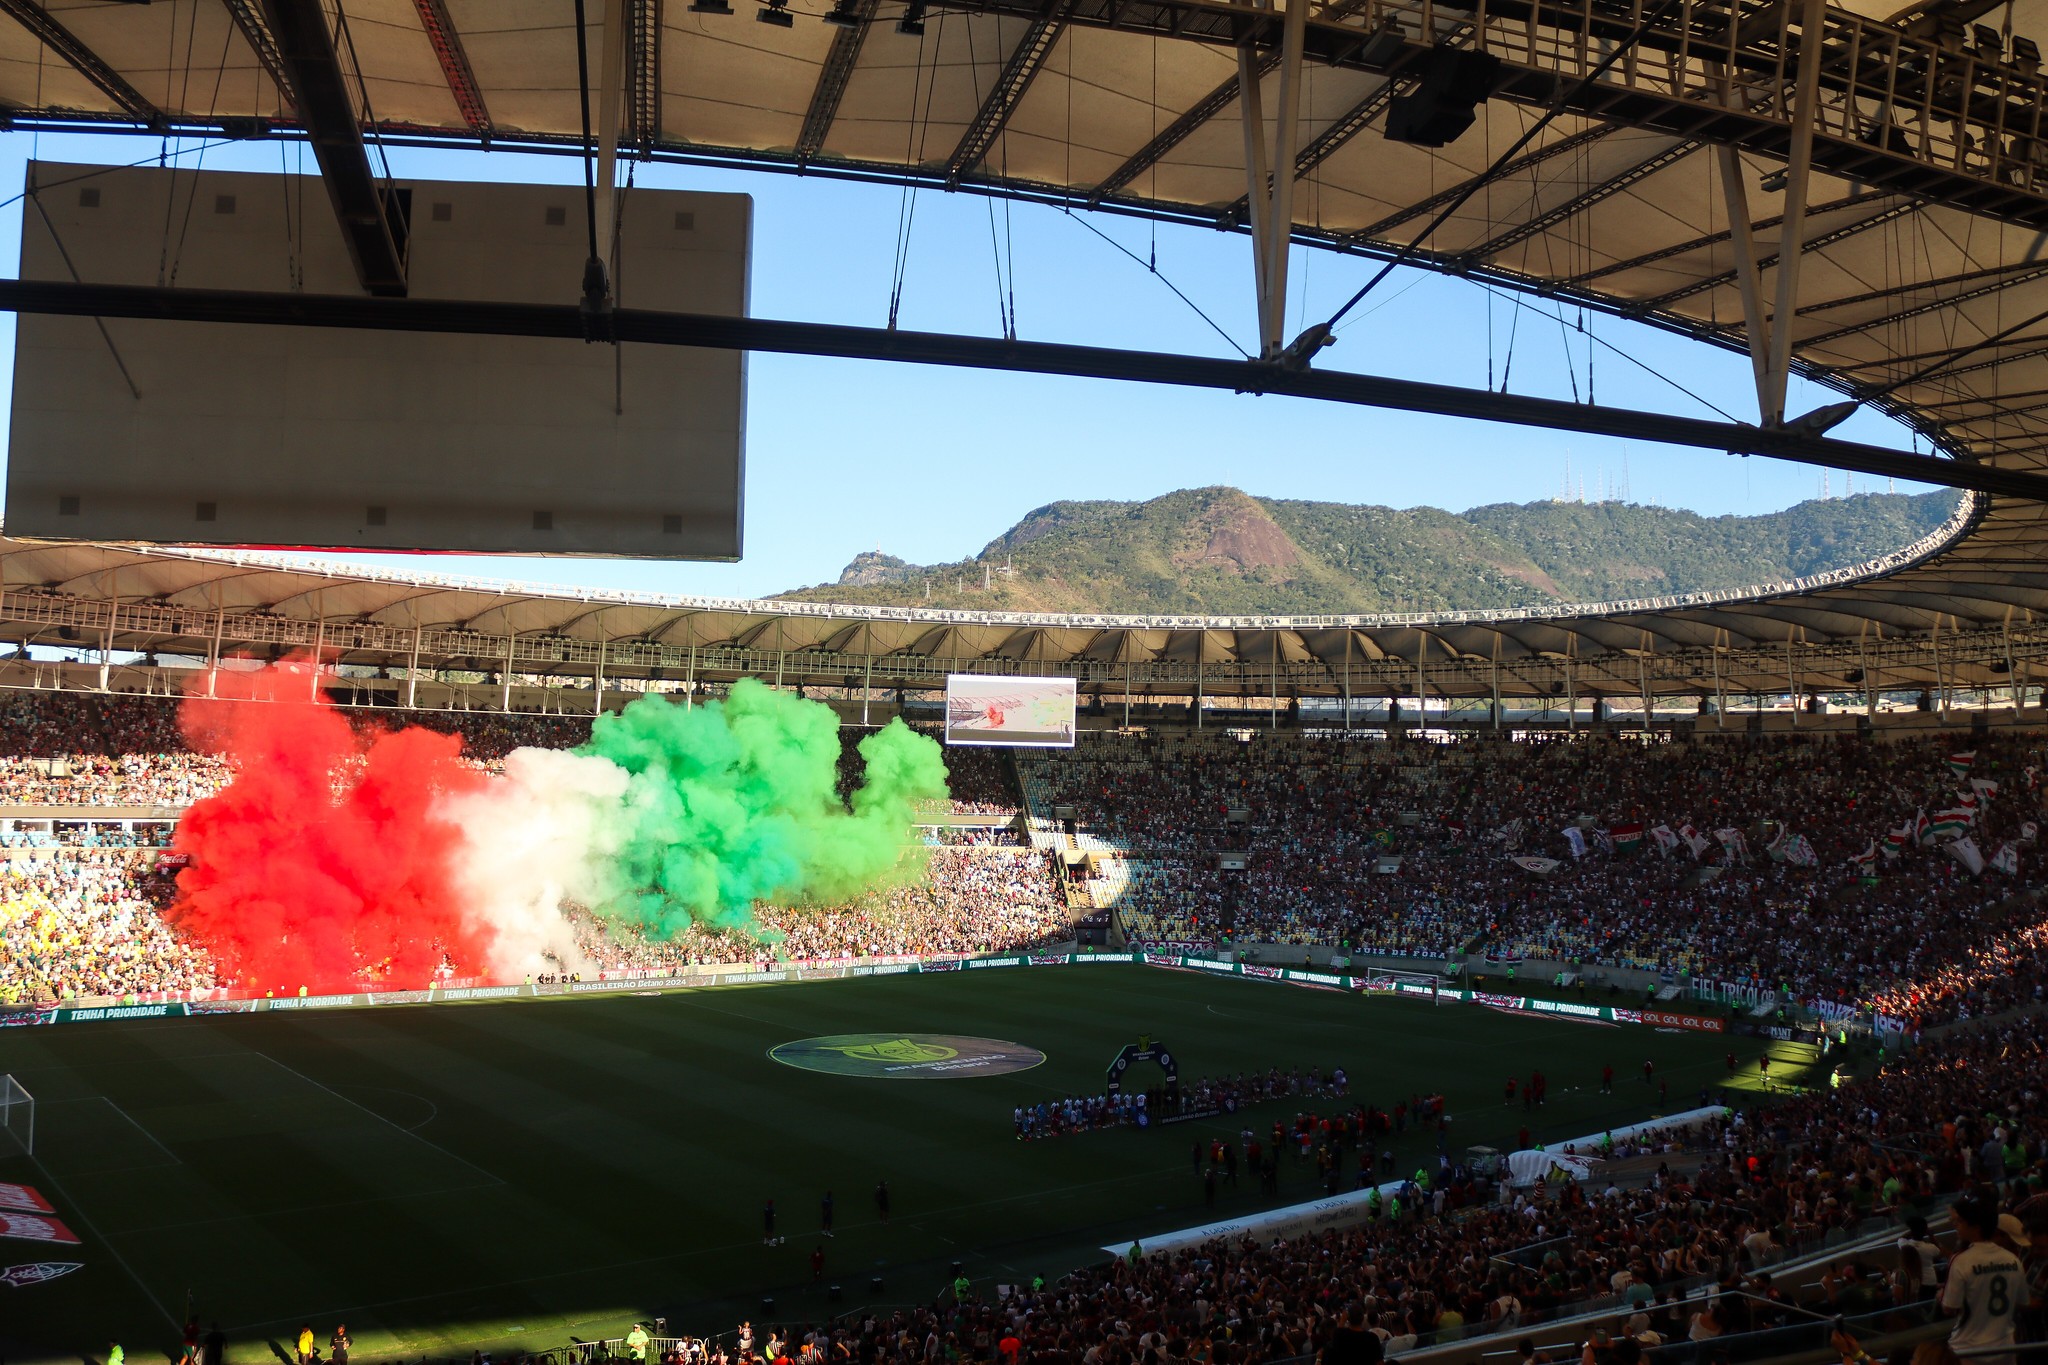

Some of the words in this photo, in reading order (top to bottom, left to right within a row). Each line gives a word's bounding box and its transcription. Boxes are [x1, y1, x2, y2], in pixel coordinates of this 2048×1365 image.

[1076, 954, 1095, 962] TENHA
[1095, 954, 1133, 962] PRIORIDADE
[1355, 947, 1386, 955] JUIZ
[1391, 948, 1408, 956] DE
[1413, 950, 1446, 959] FORA
[969, 959, 987, 968] TENHA
[987, 957, 1019, 967] PRIORIDADE
[1187, 958, 1203, 967] TENHA
[1203, 960, 1234, 971] PRIORIDADE
[853, 967, 873, 976] TENHA
[873, 964, 909, 975] PRIORIDADE
[725, 974, 747, 984] TENHA
[747, 971, 787, 982] PRIORIDADE
[1289, 970, 1307, 980] TENHA
[1307, 972, 1341, 985] PRIORIDADE
[572, 980, 636, 992] BRASILEIRÃO
[637, 979, 664, 988] Betano
[665, 978, 687, 986] 2024
[1692, 977, 1716, 1001] FIEL
[444, 989, 473, 1000] TENHA
[472, 986, 519, 999] PRIORIDADE
[269, 998, 299, 1010] TENHA
[300, 995, 353, 1008] PRIORIDADE
[1532, 999, 1557, 1012] TENHA
[1556, 1002, 1600, 1017] PRIORIDADE
[71, 1008, 105, 1021] TENHA
[106, 1005, 167, 1019] PRIORIDADE
[1644, 1012, 1661, 1023] GOL
[1663, 1014, 1680, 1026] GOL
[1683, 1017, 1700, 1028] GOL
[1702, 1020, 1720, 1031] GOL
[1972, 1261, 2018, 1275] Unimed
[1988, 1274, 2010, 1317] 8
